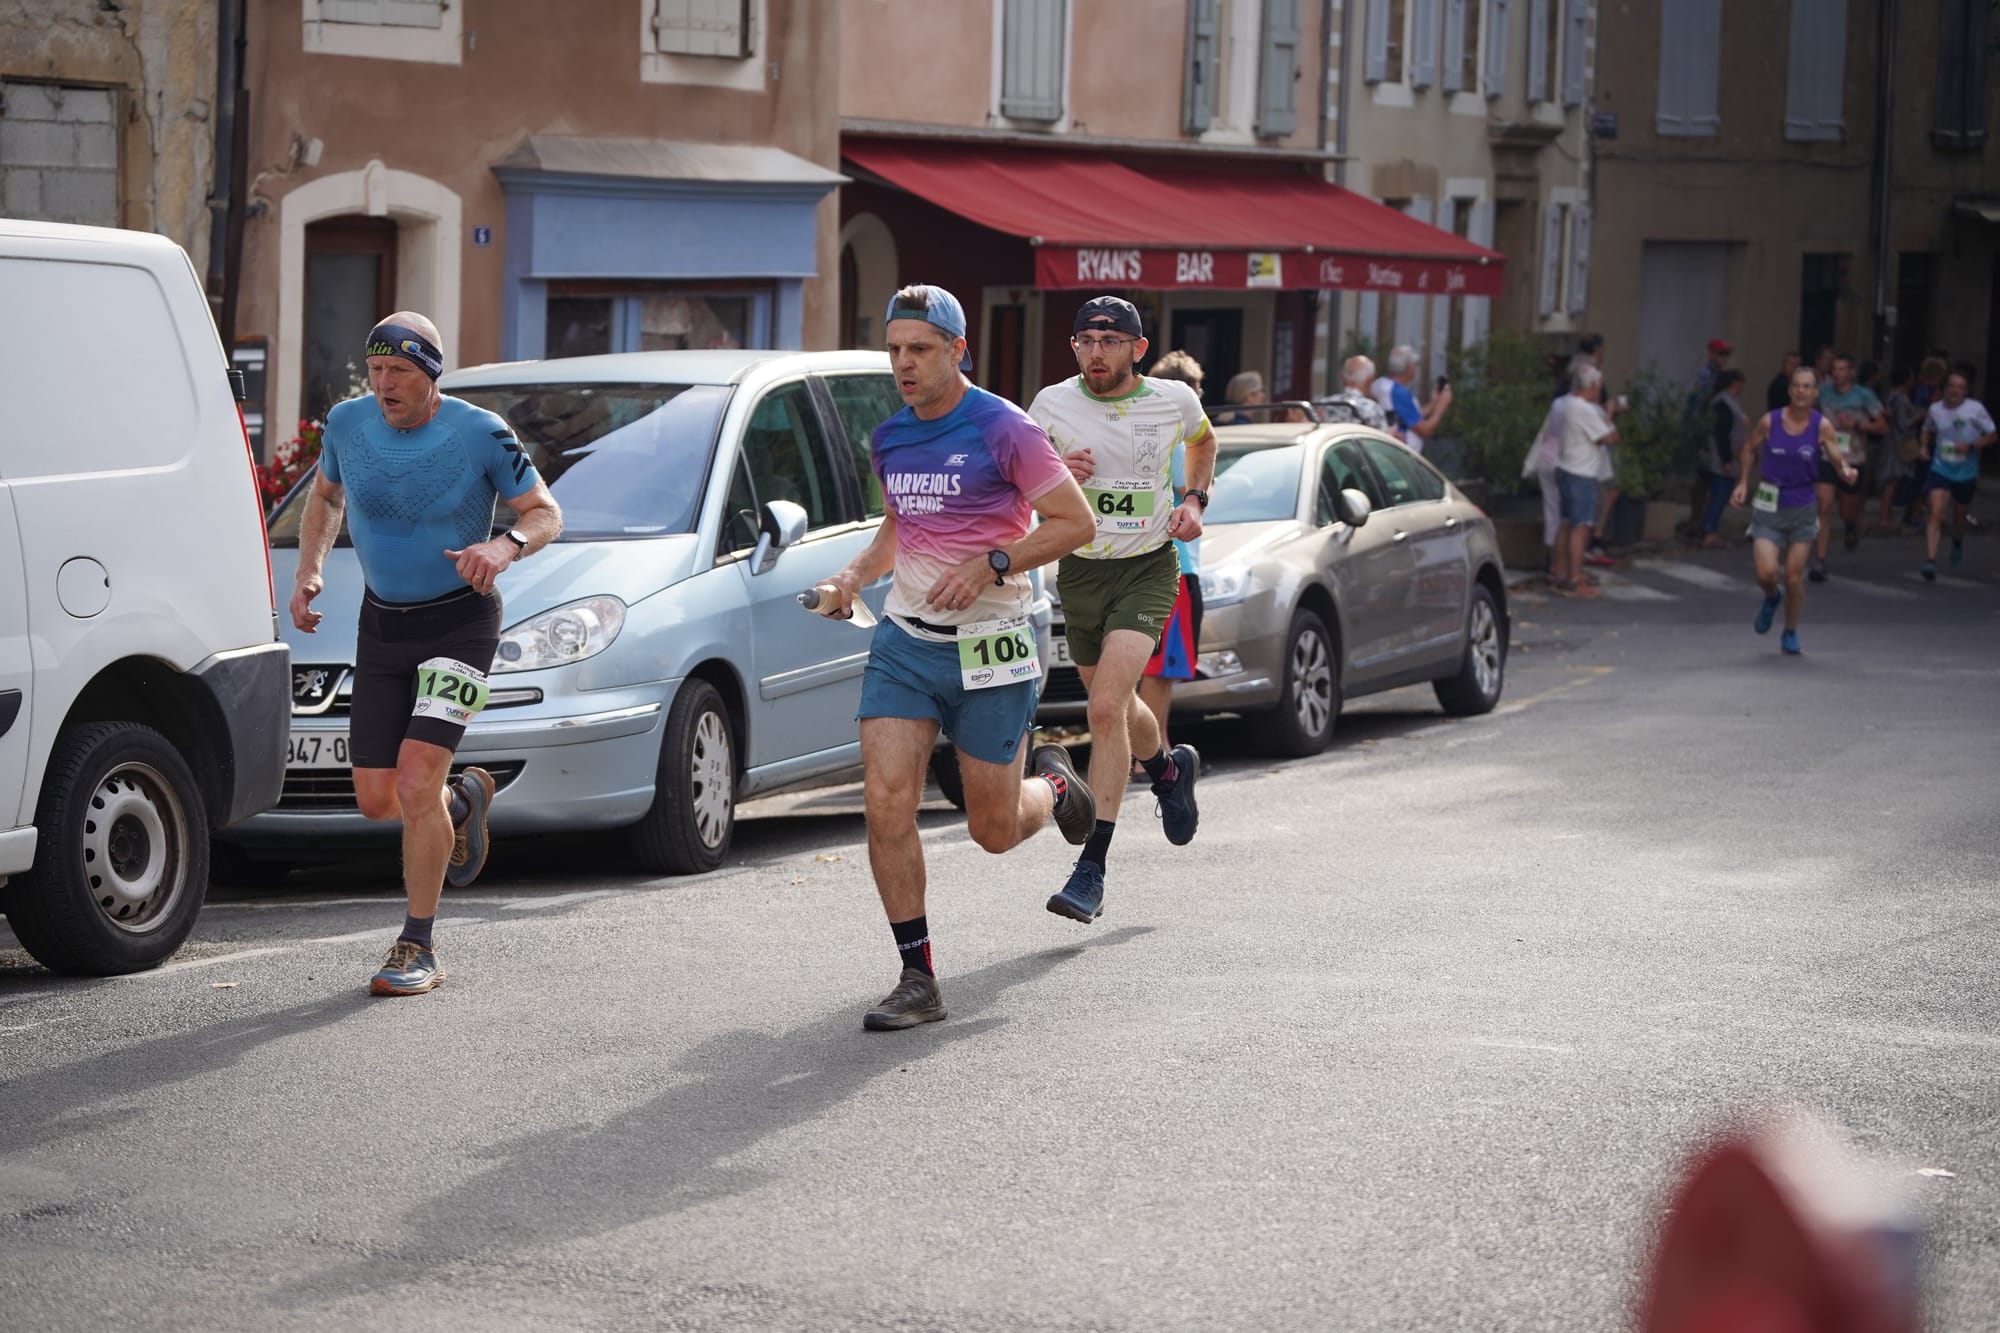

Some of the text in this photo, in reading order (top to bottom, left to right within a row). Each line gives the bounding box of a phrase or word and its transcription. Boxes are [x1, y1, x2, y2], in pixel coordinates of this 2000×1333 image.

[1077, 249, 1142, 281] RYAN'S
[1176, 252, 1214, 282] BAR
[1098, 493, 1134, 515] 64
[974, 633, 1029, 665] 108
[426, 672, 478, 706] 120
